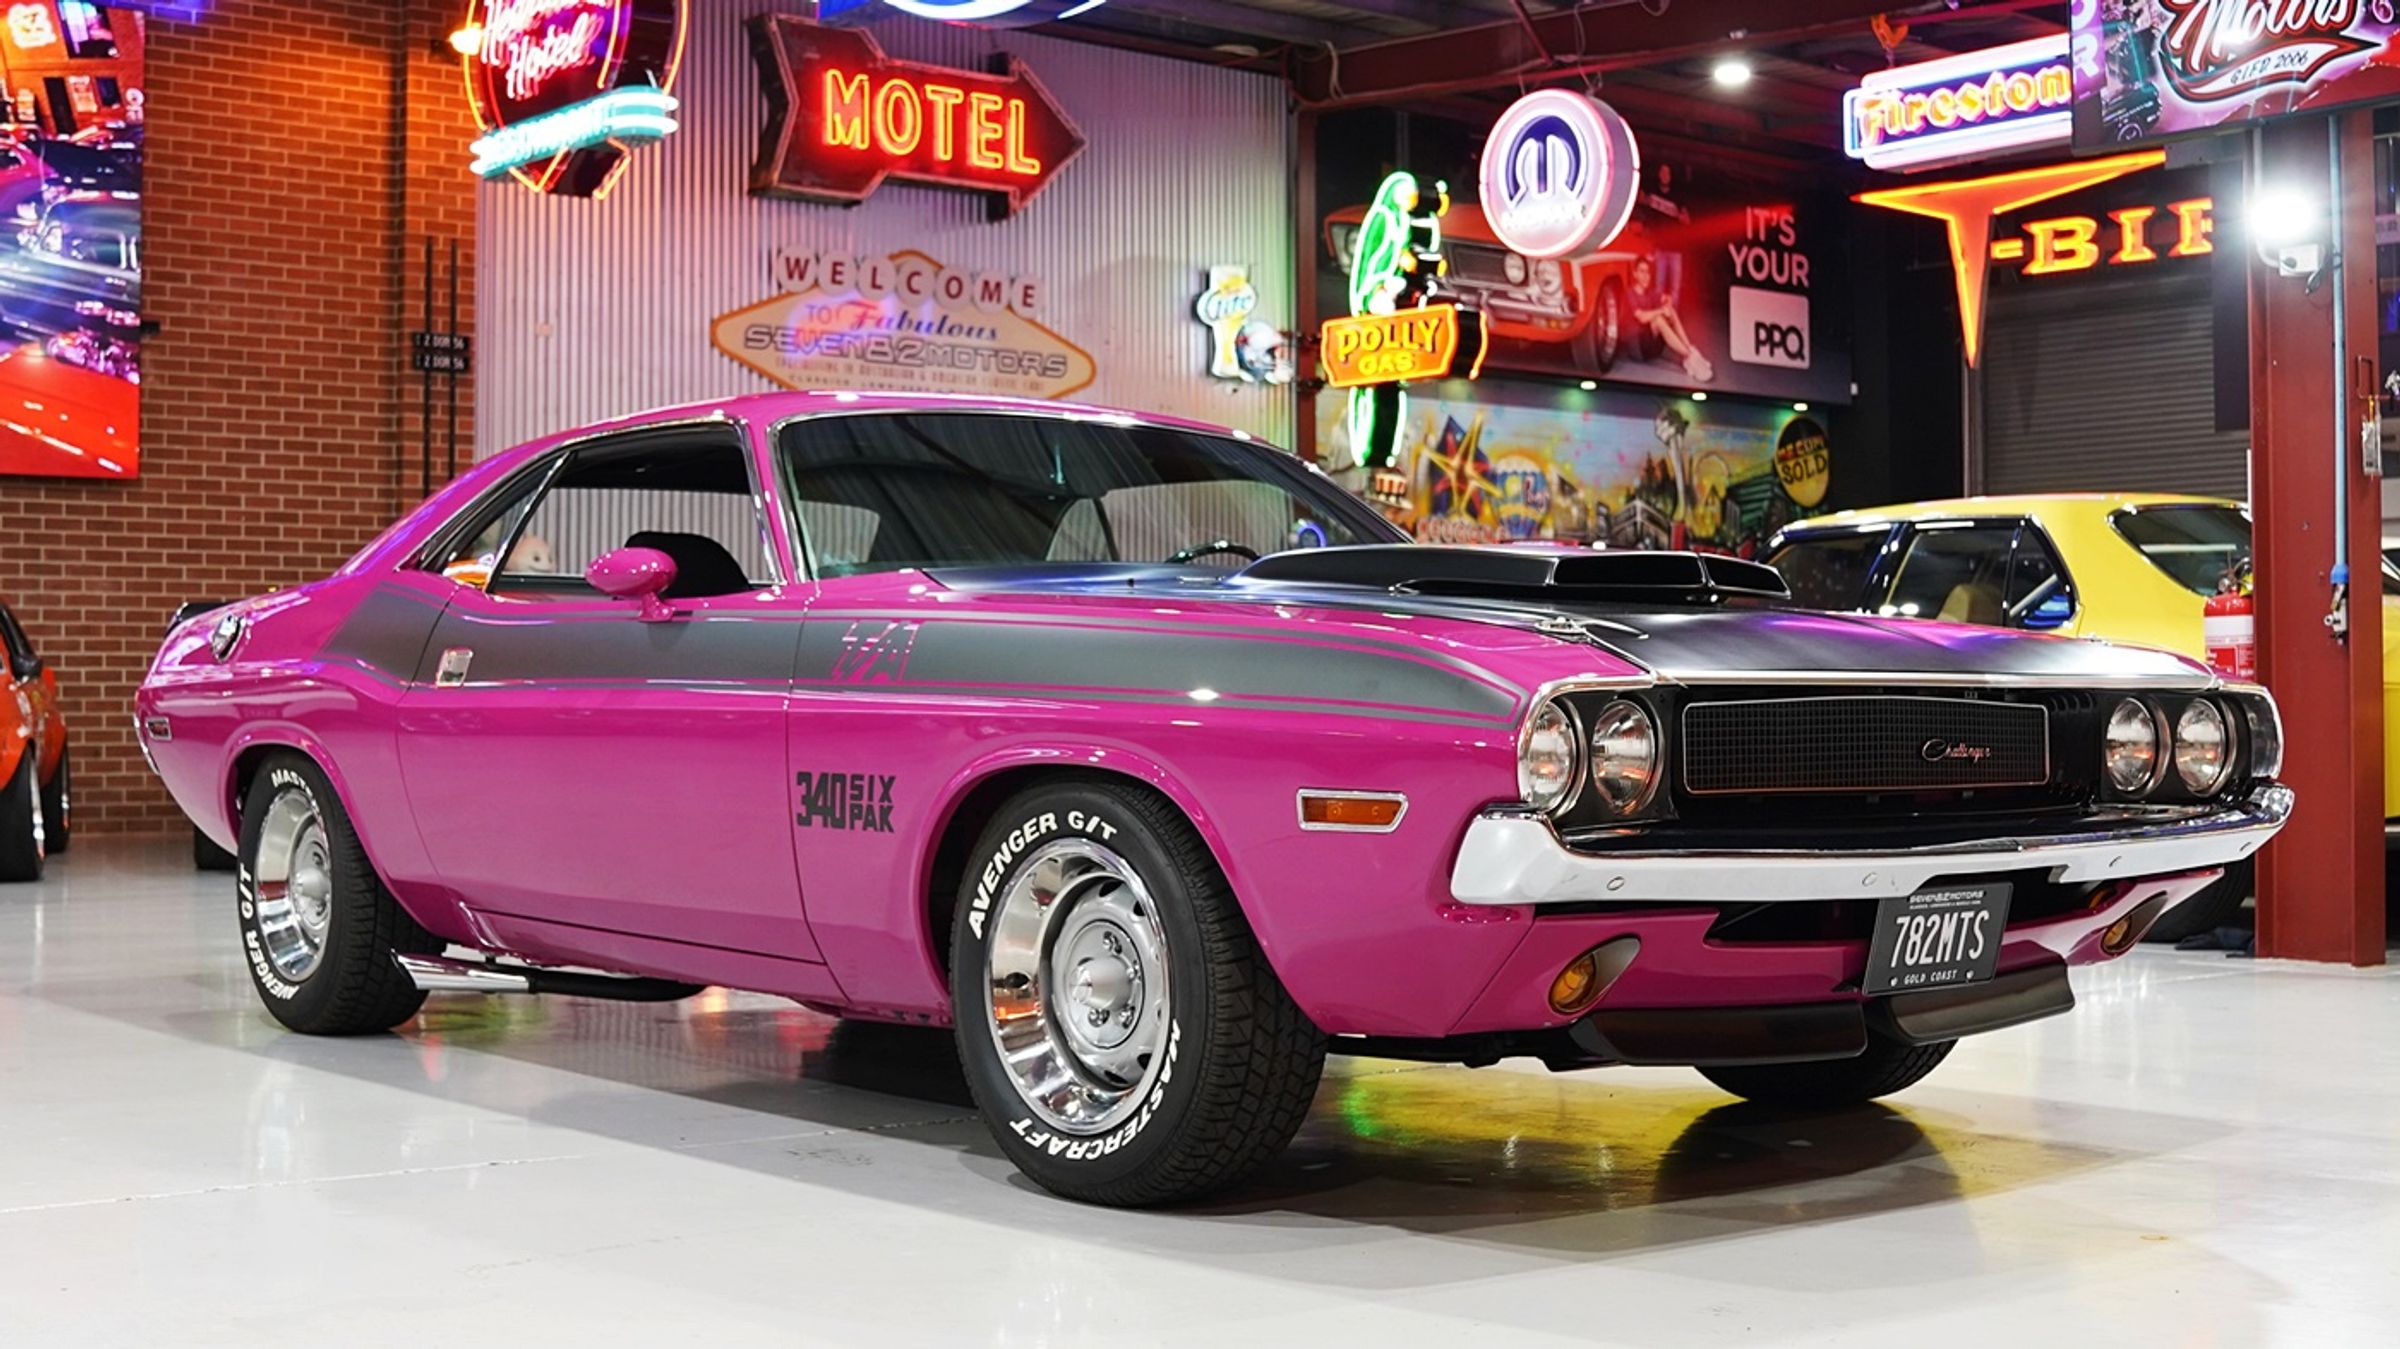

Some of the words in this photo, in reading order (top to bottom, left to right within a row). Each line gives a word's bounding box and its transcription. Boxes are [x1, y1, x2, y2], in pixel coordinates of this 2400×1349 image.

[505, 11, 594, 99] Hotel
[2274, 49, 2308, 69] 2006
[824, 68, 1042, 176] MOTEL
[1860, 64, 2072, 147] Fireston
[1746, 205, 1796, 246] IT'S
[784, 256, 1037, 310] WELCOME
[1728, 242, 1809, 288] YOUR
[806, 304, 833, 324] TO
[841, 300, 1000, 341] Fabulous
[1335, 317, 1441, 363] POLLY
[1754, 320, 1806, 361] PPQ
[1358, 351, 1415, 376] GAS
[1781, 454, 1827, 485] SOLD
[796, 771, 847, 830] 340
[849, 773, 897, 804] SIX
[849, 803, 895, 834] PAK
[240, 862, 254, 919] G/T
[968, 811, 1058, 940] AVENGER
[1067, 810, 1118, 840] G/T
[1890, 909, 1990, 968] 782MTS
[245, 929, 300, 1000] AVENGER
[1904, 972, 1926, 986] GOLD
[1930, 969, 1958, 983] COAST
[1009, 1018, 1182, 1161] MASTERCRAFT
